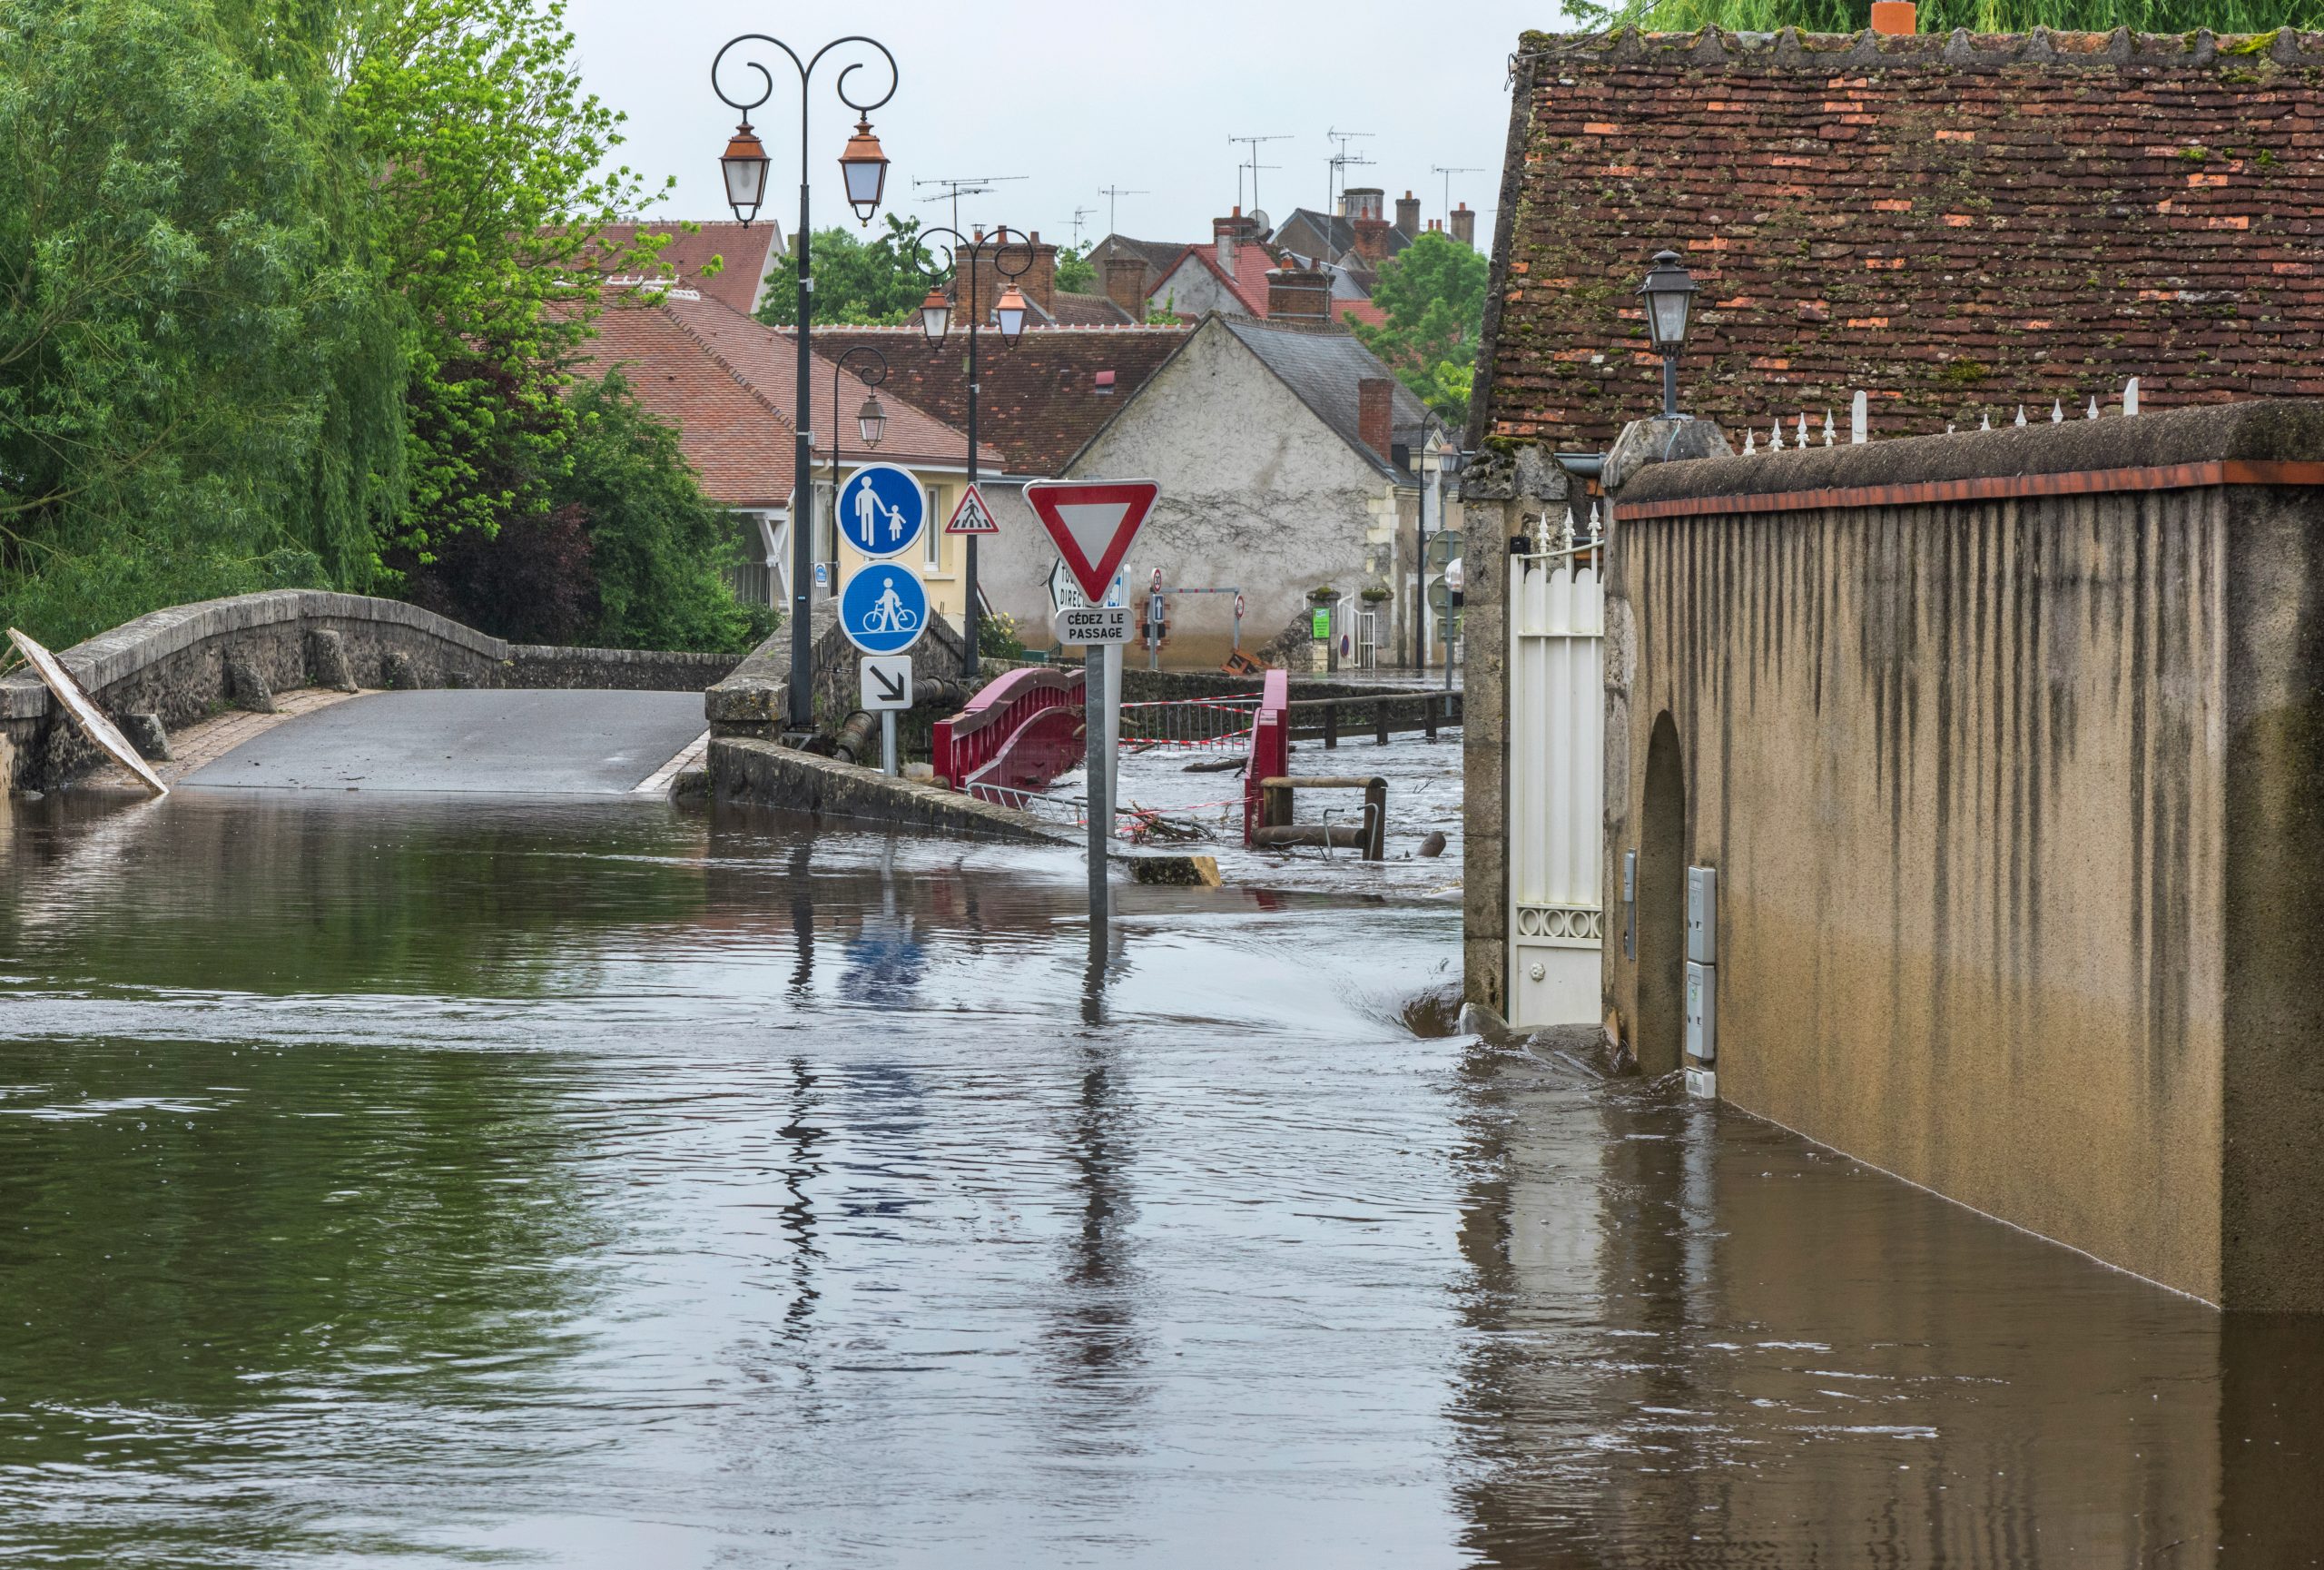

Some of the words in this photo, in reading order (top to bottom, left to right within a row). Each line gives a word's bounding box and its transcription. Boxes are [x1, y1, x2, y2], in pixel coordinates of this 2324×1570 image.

[1068, 612, 1103, 625] CÉDEZ
[1110, 613, 1124, 624] LE
[1068, 627, 1122, 639] PASSAGE
